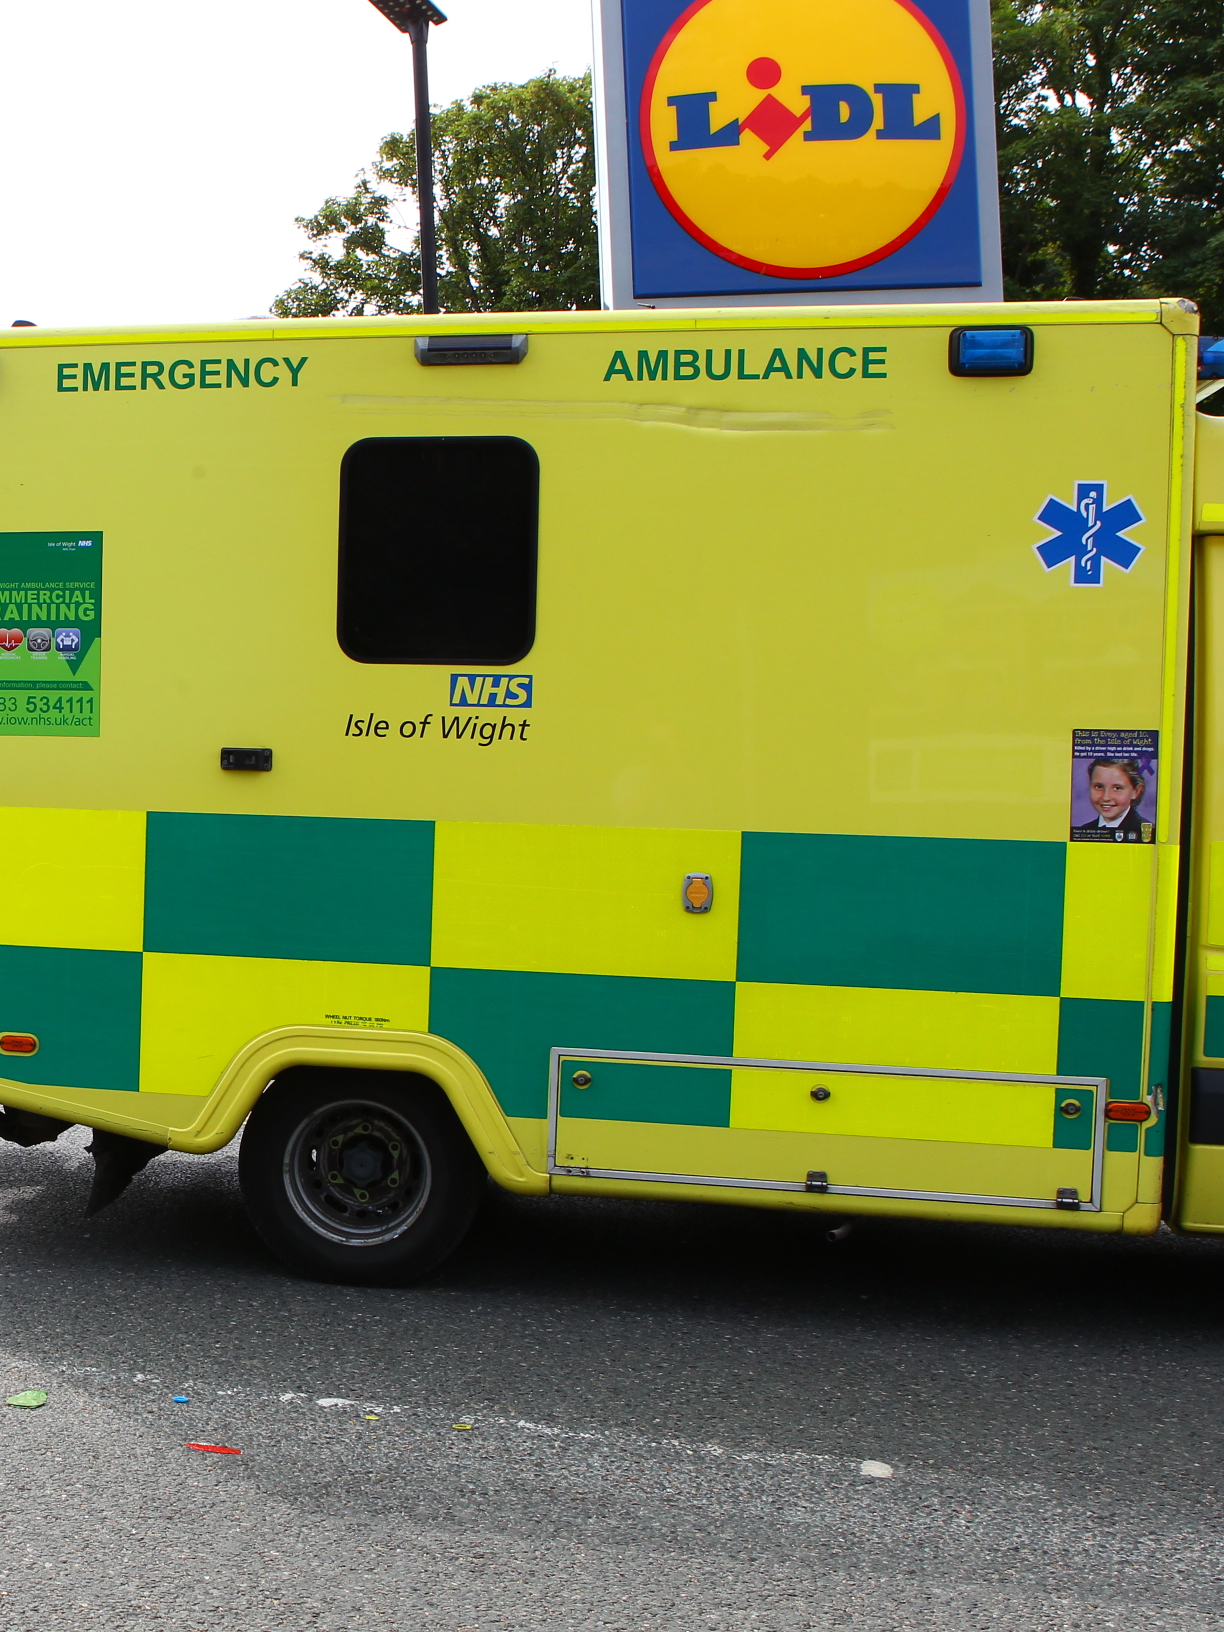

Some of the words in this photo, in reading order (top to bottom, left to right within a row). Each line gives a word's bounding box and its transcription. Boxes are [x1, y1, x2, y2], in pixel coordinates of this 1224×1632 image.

[56, 356, 309, 393] EMERGENCY
[603, 346, 888, 382] AMBULANCE
[65, 581, 96, 589] SERVICE
[36, 682, 58, 690] please
[450, 675, 531, 707] NHS
[25, 696, 94, 714] 534111
[344, 713, 390, 739] Isle
[398, 713, 434, 739] of
[440, 715, 531, 747] Wight
[1091, 730, 1099, 738] is
[1120, 731, 1138, 740] aged
